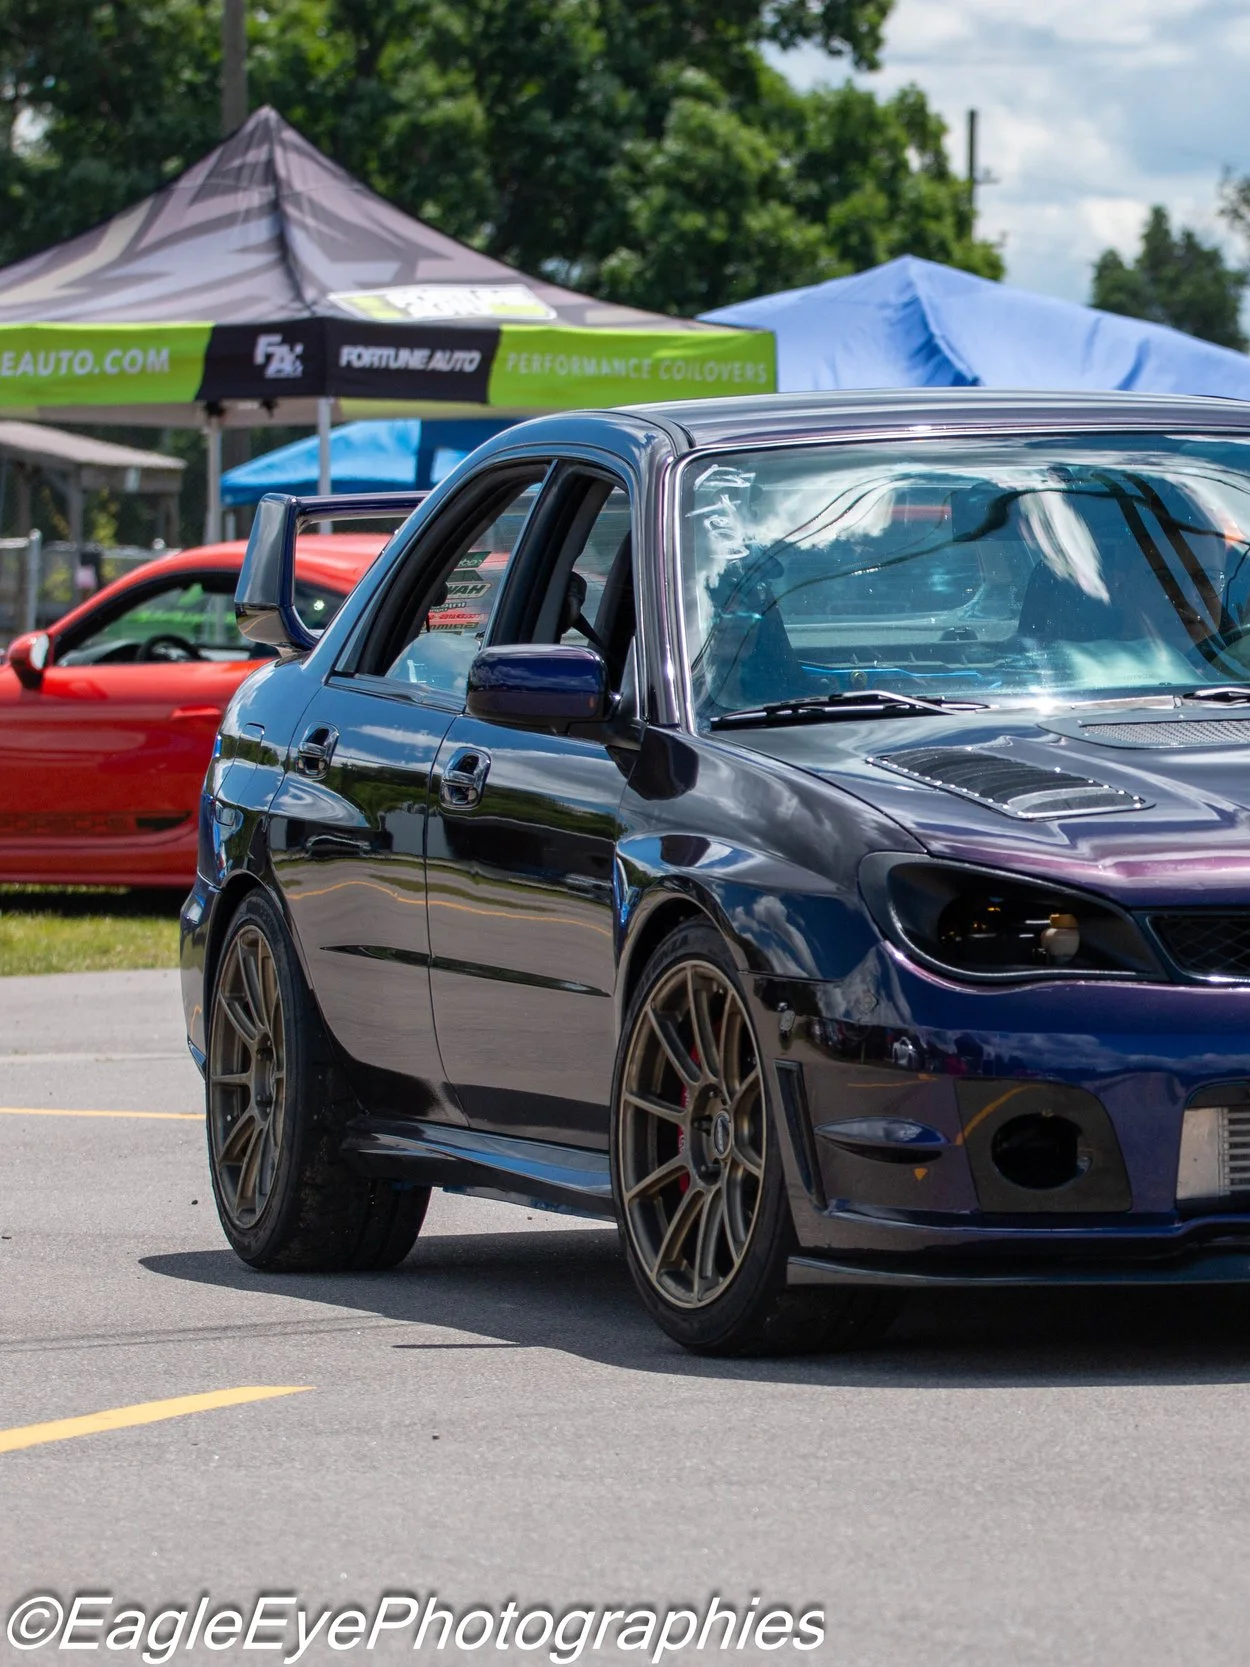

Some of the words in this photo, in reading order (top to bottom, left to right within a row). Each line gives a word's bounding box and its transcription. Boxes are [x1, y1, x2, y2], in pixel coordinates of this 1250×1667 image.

[339, 345, 429, 369] FORTUNE
[427, 350, 482, 372] AUTO
[507, 352, 653, 379] PERFORMANCE
[659, 359, 768, 384] COILOVERS
